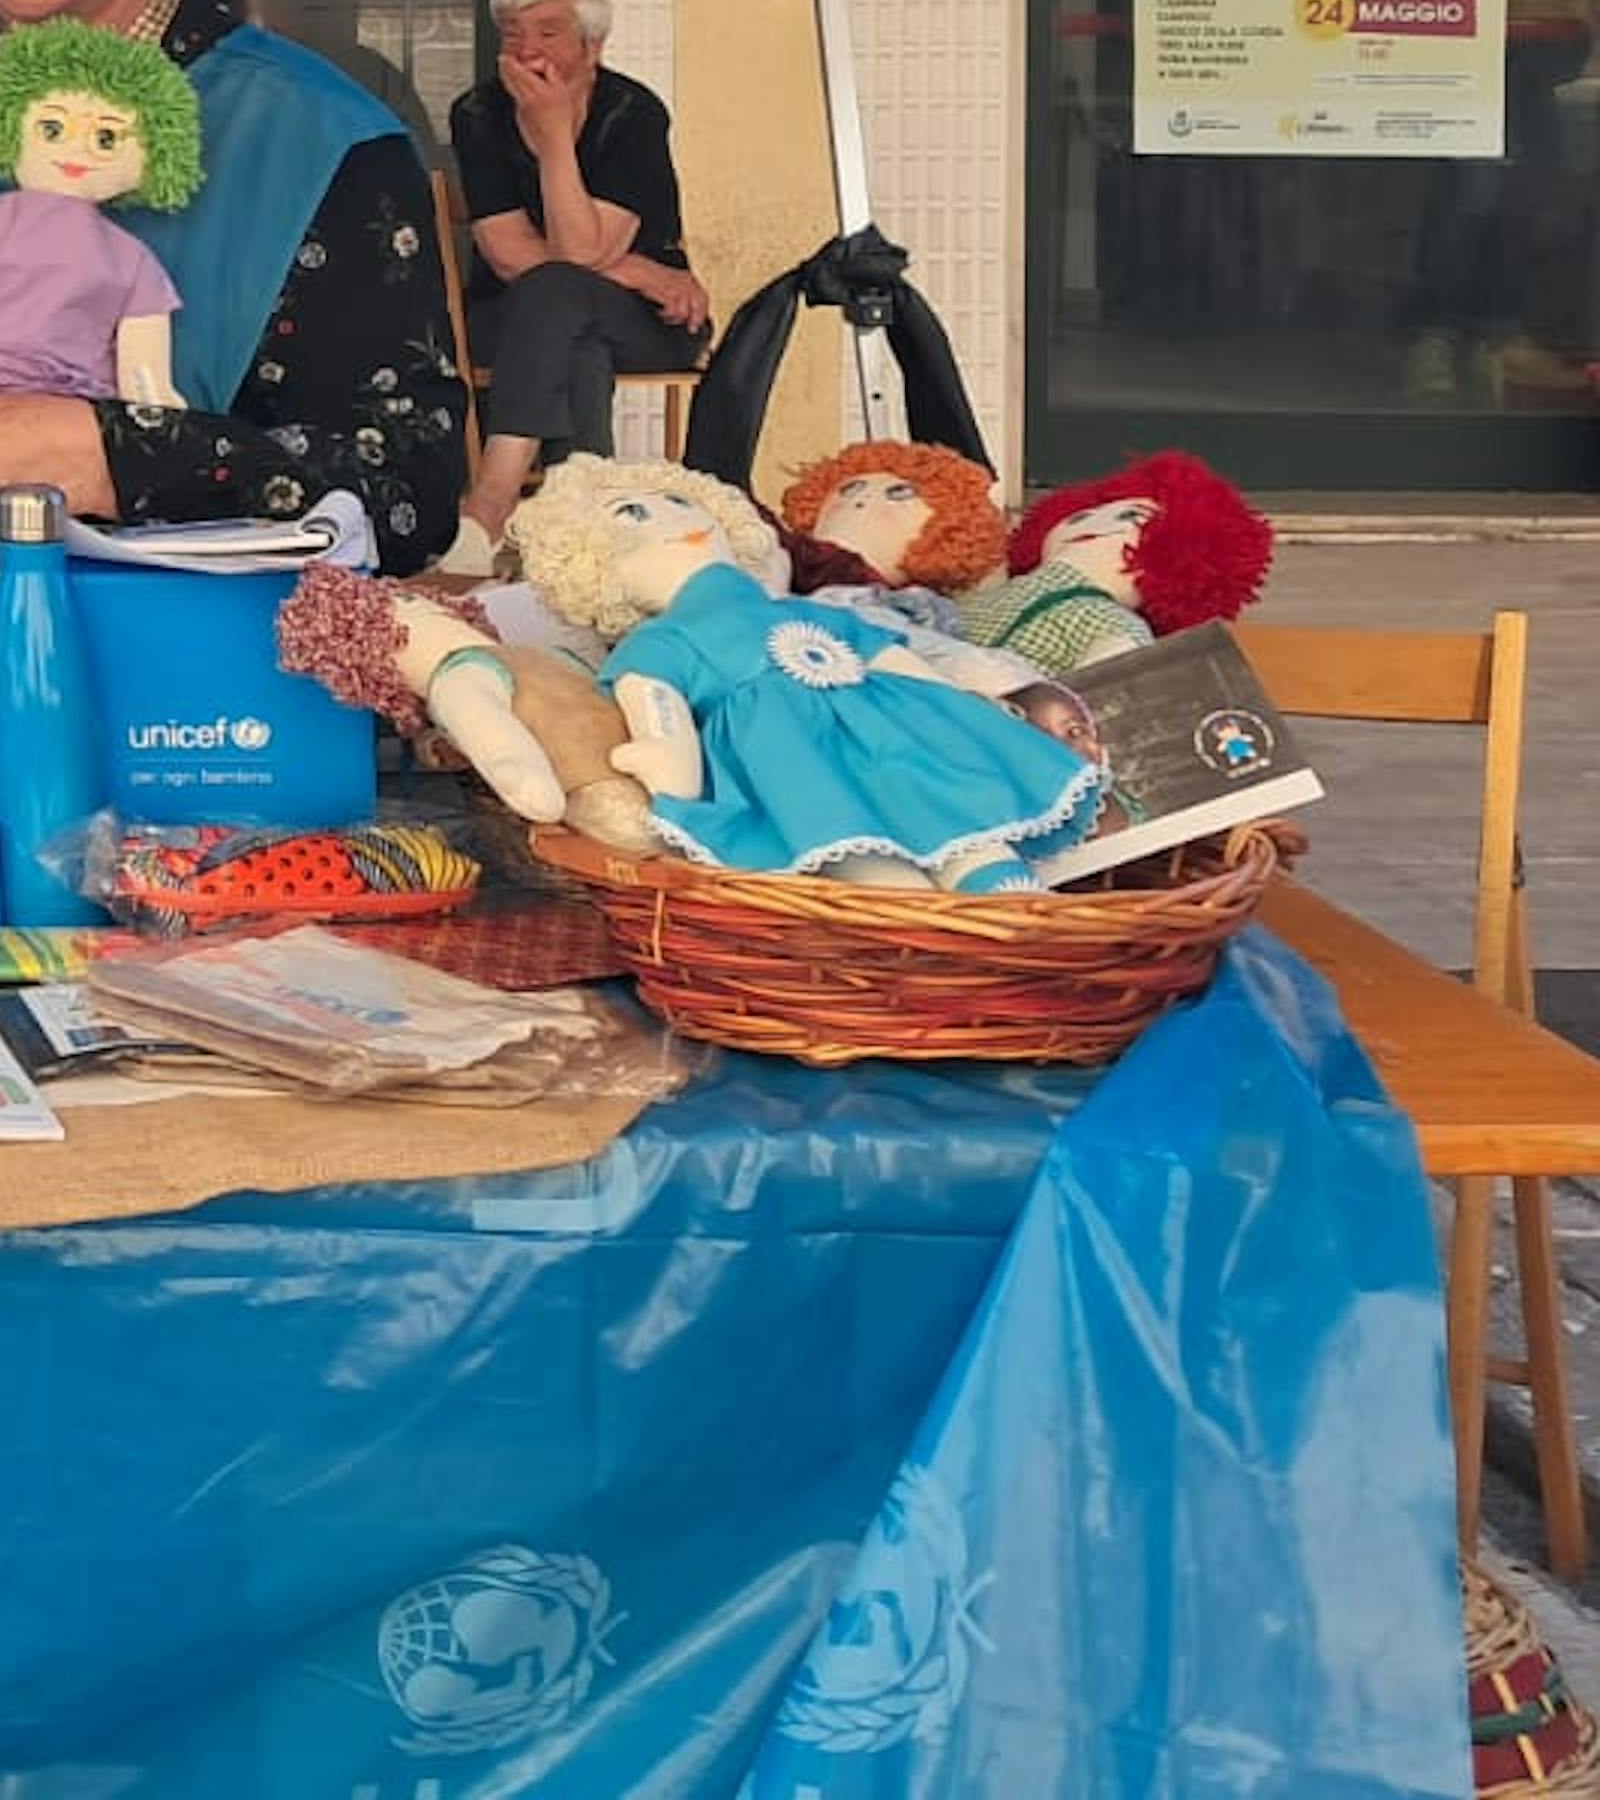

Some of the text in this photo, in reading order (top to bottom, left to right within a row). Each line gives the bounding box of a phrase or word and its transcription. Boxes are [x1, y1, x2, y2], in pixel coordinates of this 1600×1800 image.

[1305, 0, 1464, 24] 24 MAGGIO
[128, 716, 228, 749] unicef
